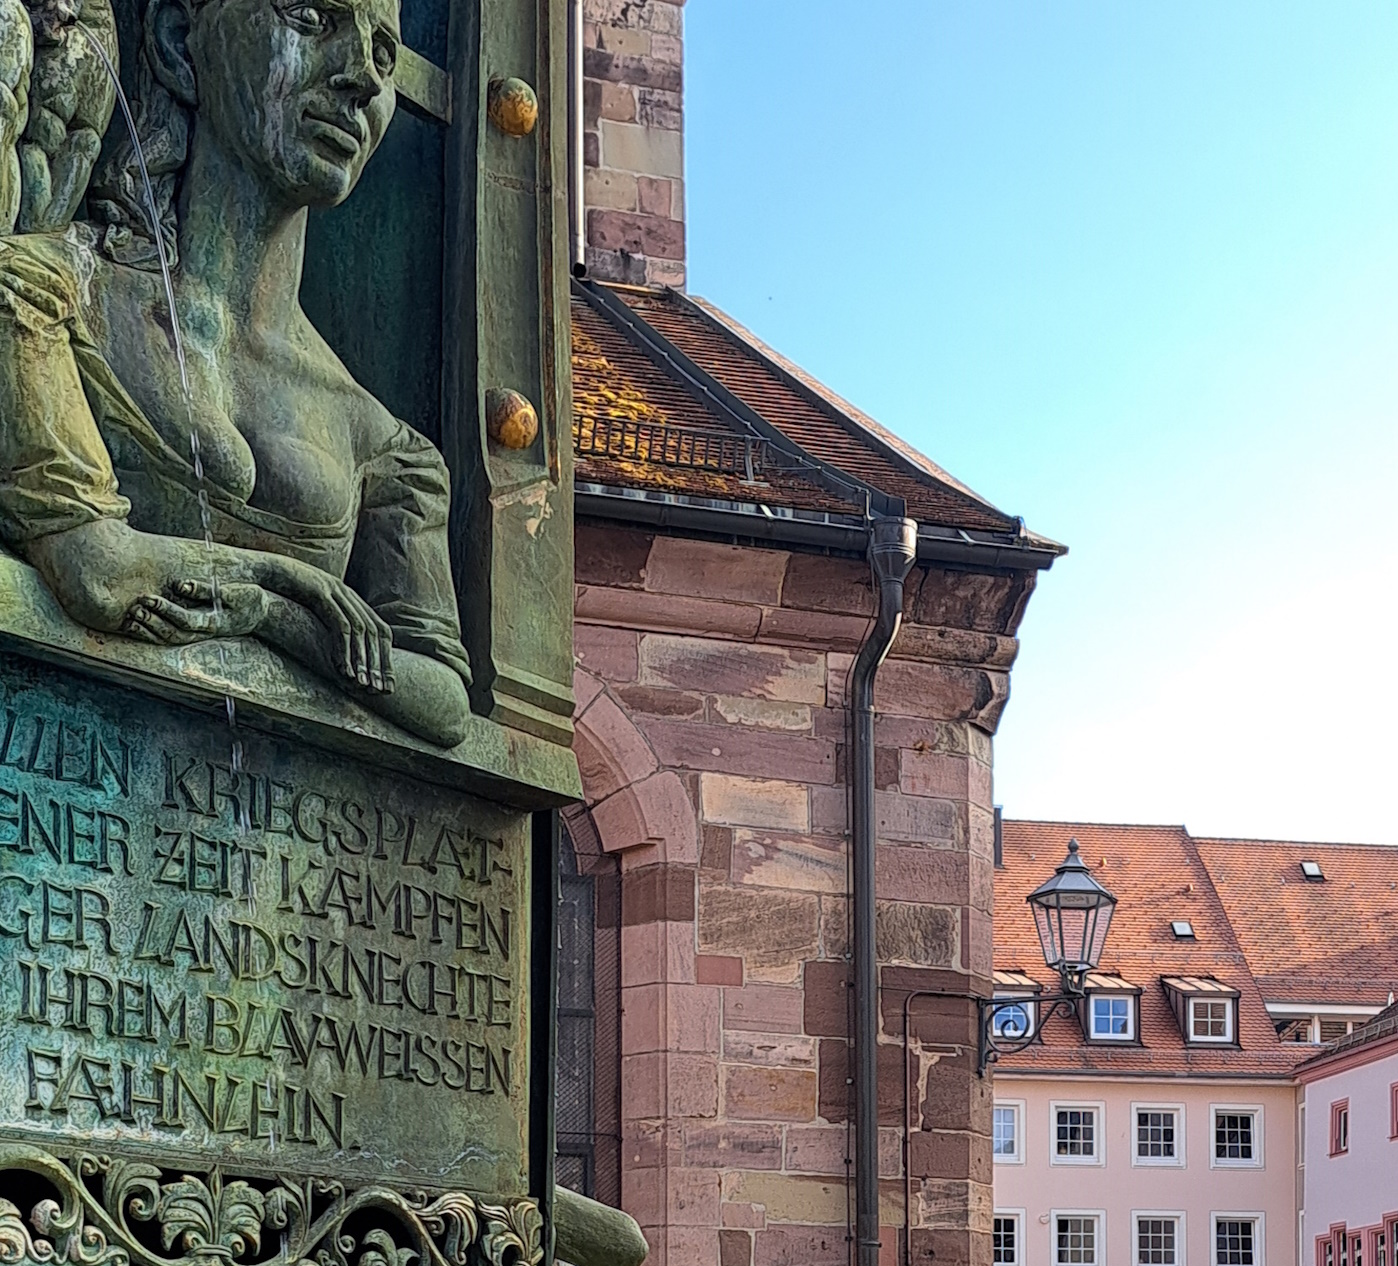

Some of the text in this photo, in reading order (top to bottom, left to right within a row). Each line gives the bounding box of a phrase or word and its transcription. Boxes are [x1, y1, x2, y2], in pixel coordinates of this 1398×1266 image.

[152, 823, 267, 902] ZEIT
[17, 959, 190, 1046] IHREM
[133, 901, 512, 1028] LANDSKNECHTE
